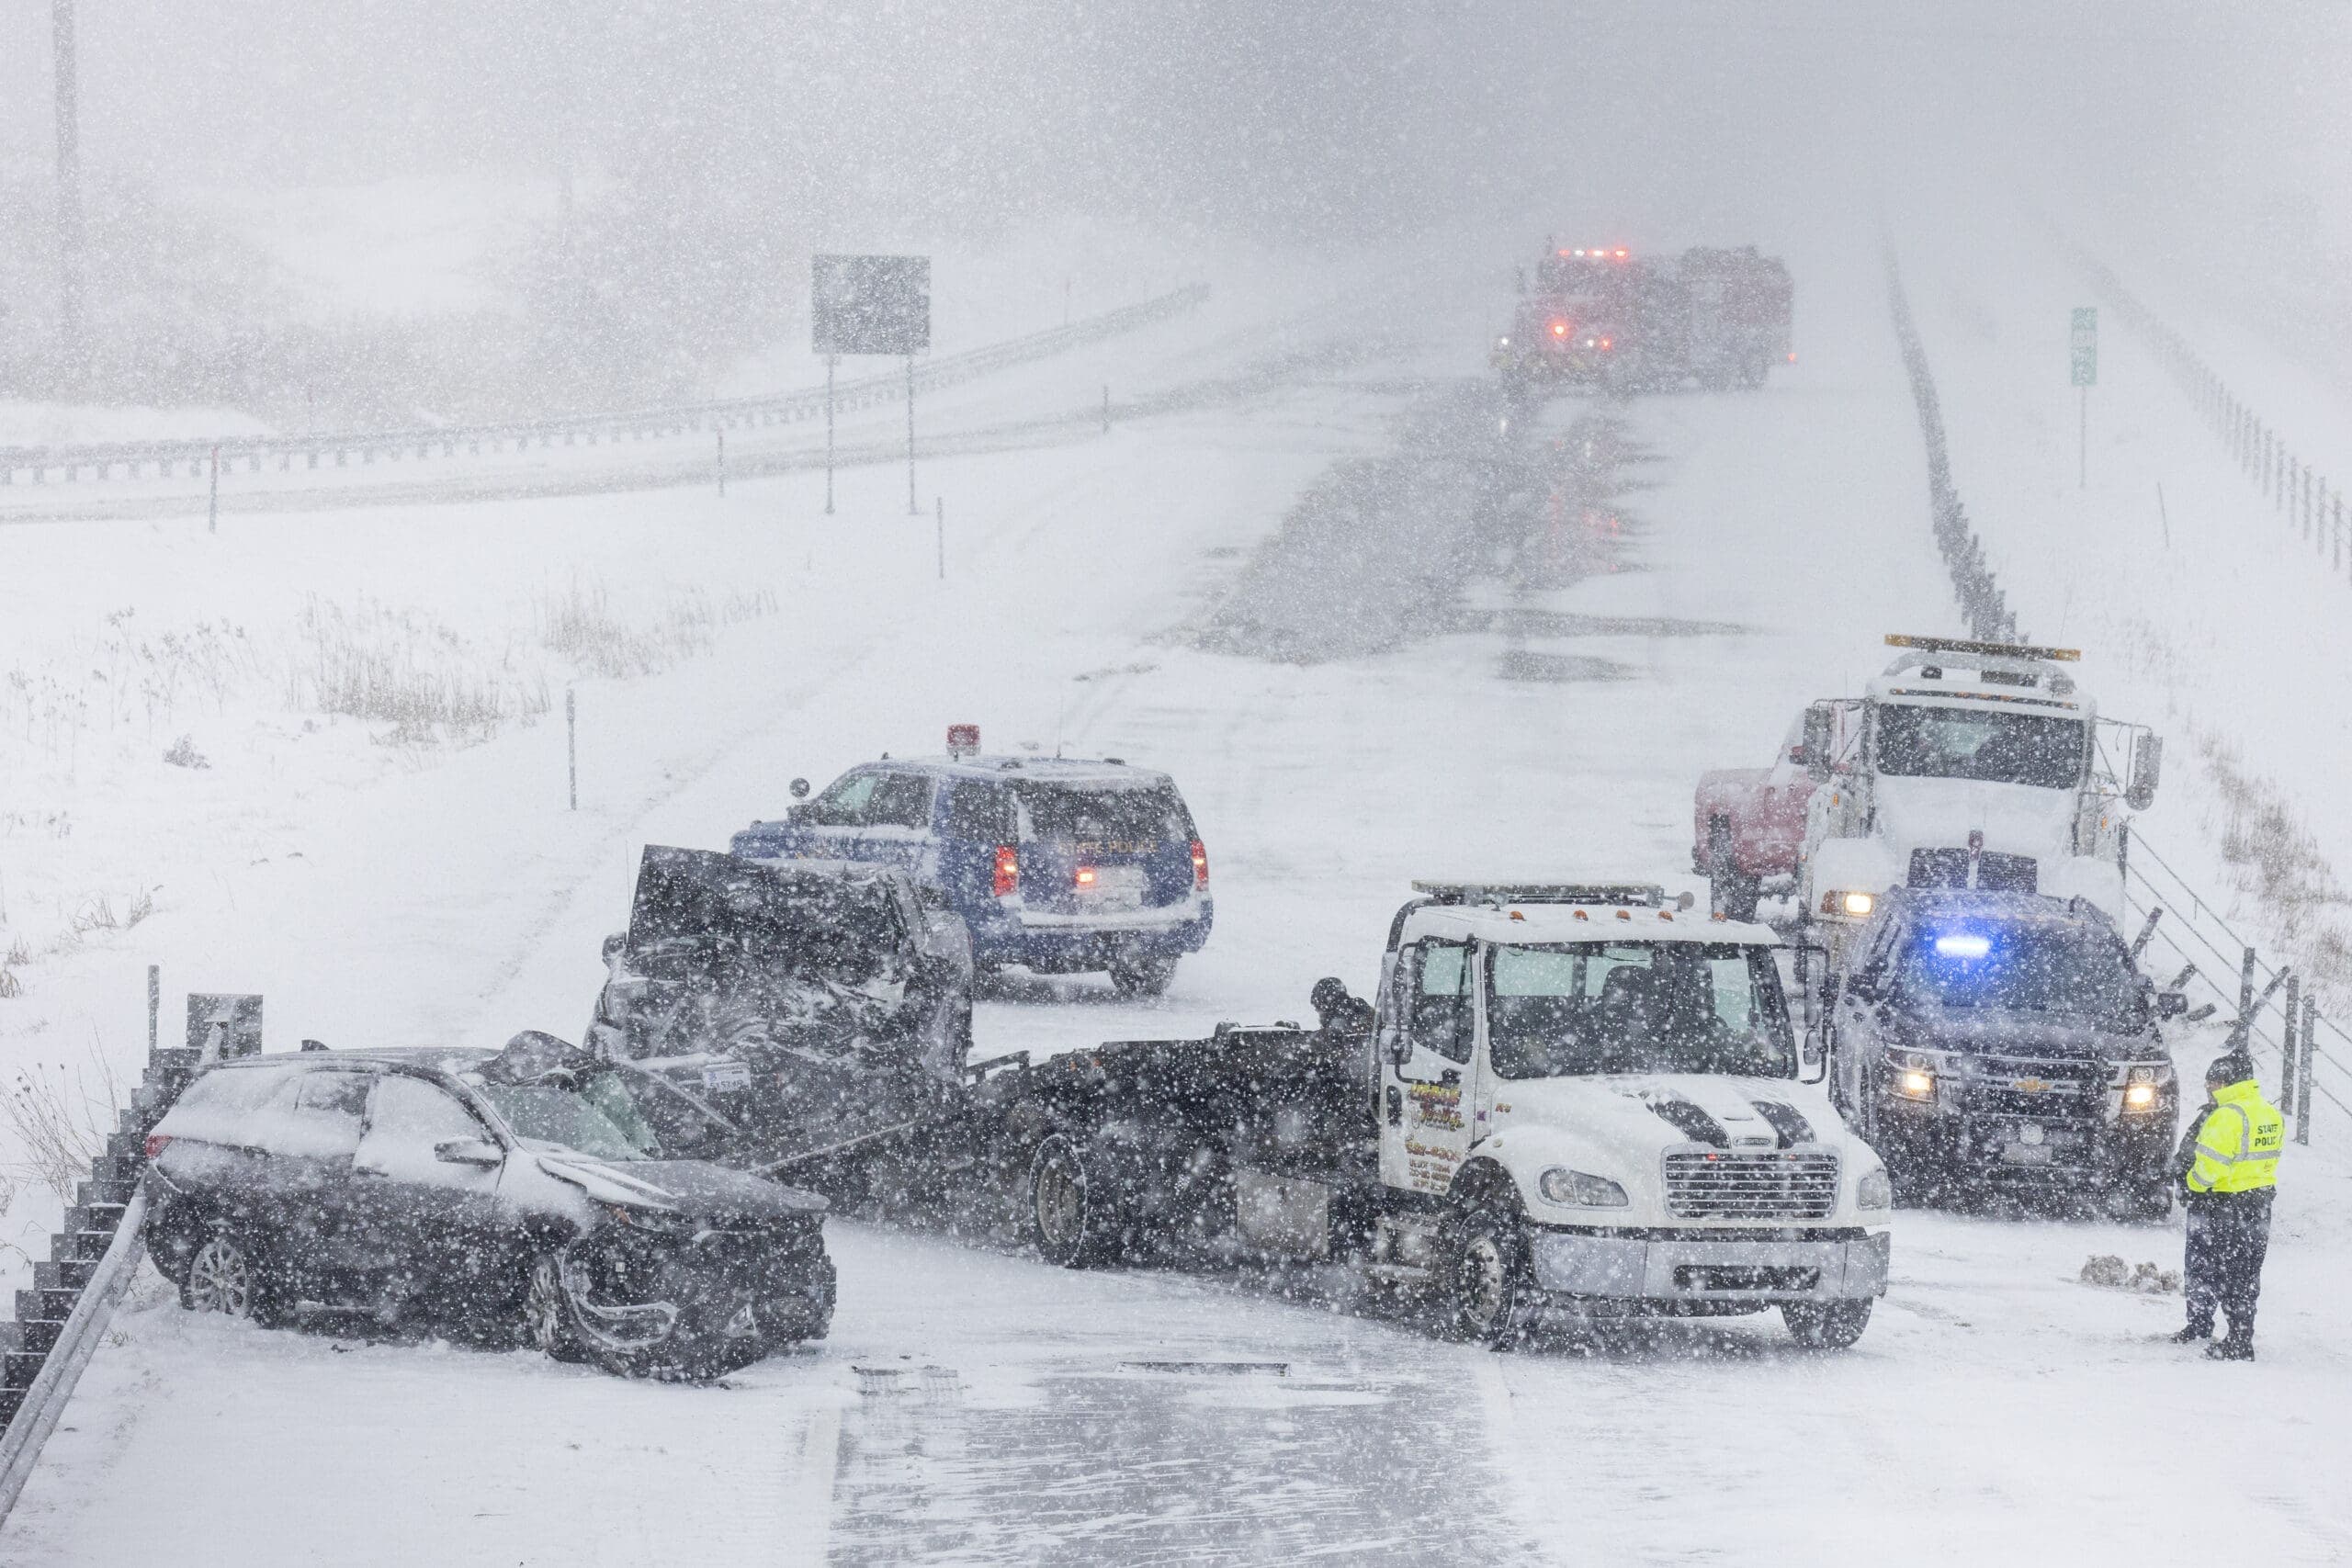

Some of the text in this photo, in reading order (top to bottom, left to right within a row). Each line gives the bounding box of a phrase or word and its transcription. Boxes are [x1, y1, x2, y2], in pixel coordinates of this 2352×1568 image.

[1058, 840, 1159, 855] STATE POLICE
[2257, 1123, 2278, 1134] STATE
[2254, 1135, 2277, 1147] POLIC
